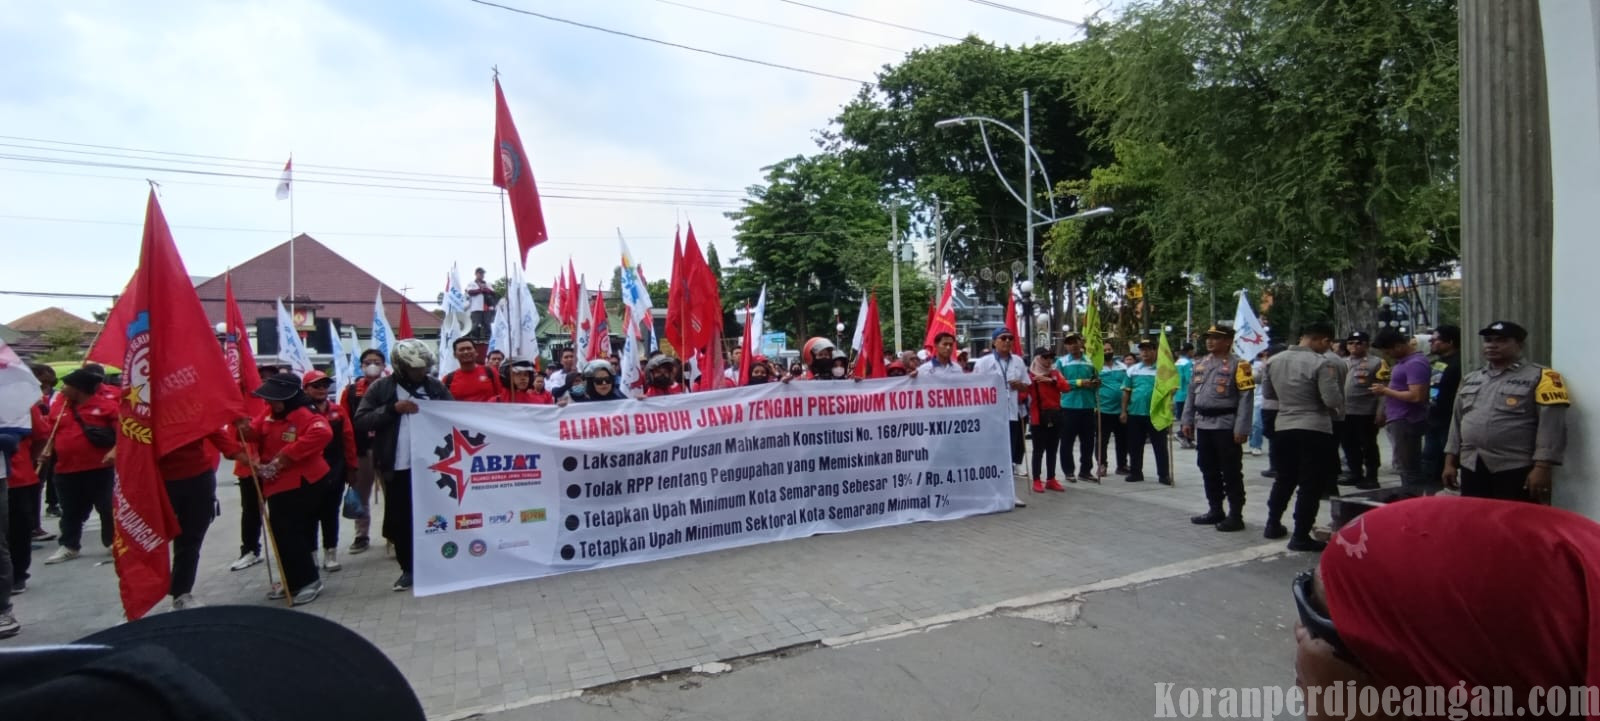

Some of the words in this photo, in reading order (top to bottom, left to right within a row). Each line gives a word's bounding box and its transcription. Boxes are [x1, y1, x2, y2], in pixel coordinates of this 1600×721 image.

[559, 414, 631, 441] ALIANSI
[634, 410, 692, 435] BURUH
[697, 404, 743, 428] JAWA
[748, 397, 803, 422] TENGAH
[808, 392, 885, 417] PRESIDIUM
[889, 390, 924, 411] KOTA
[928, 387, 997, 409] SEMARANG
[470, 454, 541, 473] ABJAT
[583, 449, 668, 470] Laksanakan
[672, 442, 721, 461] Putusan
[725, 432, 790, 454] Mahkamah
[793, 427, 853, 446] Konstitusi
[856, 427, 873, 442] No.
[877, 418, 981, 440] 168/PUU-XXI/2023
[585, 480, 622, 498] Tolak
[627, 476, 653, 494] RPP
[658, 471, 708, 490] tentang
[711, 461, 784, 483] Pengupahan
[787, 459, 815, 475] yang
[819, 451, 893, 471] Memiskinkan
[896, 447, 929, 463] Buruh
[580, 536, 645, 558] Tetapkan
[649, 529, 682, 549] Upah
[686, 521, 742, 542] Minimum
[746, 510, 796, 532] Sektoral
[800, 507, 825, 523] Kota
[829, 502, 884, 519] Semarang
[888, 494, 931, 512] Minimal
[935, 494, 949, 508] 7%
[584, 506, 649, 528] Tetapkan
[653, 501, 686, 520] Upah
[690, 494, 745, 515] Minimum
[749, 489, 776, 506] Kota
[780, 483, 839, 501] Semarang
[843, 478, 888, 494] Sebesar
[893, 473, 912, 488] 19%
[916, 472, 922, 486] /
[926, 471, 943, 487] Rp.
